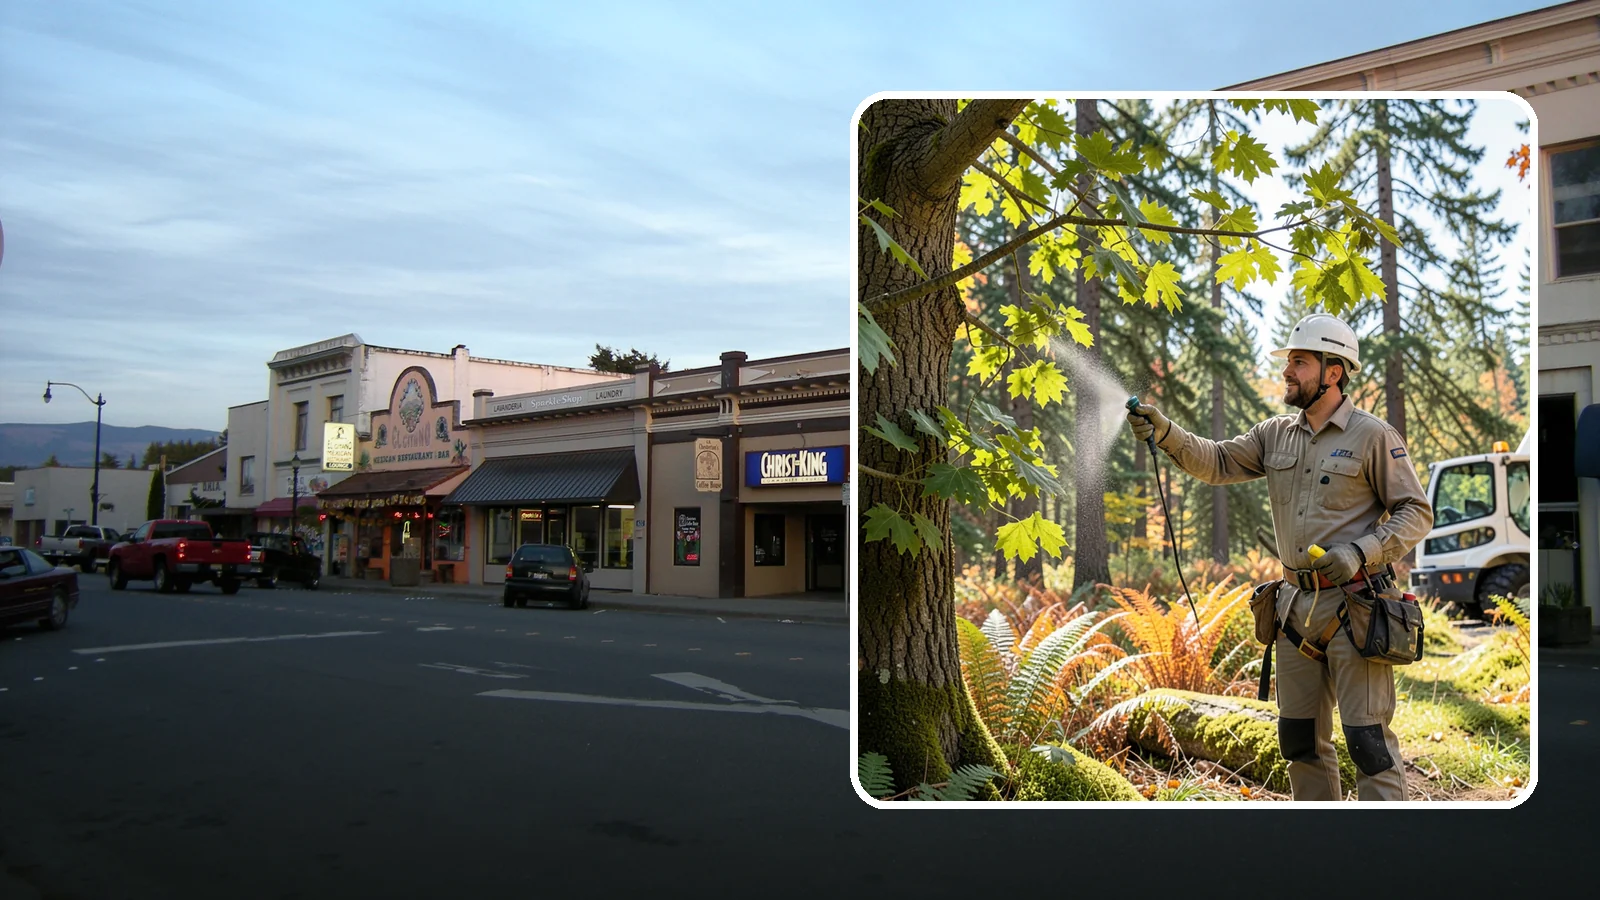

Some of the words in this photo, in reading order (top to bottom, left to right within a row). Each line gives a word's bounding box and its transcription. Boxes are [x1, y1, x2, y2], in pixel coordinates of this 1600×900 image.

[493, 402, 522, 412] LAVANDERIA
[531, 397, 560, 409] Sparkle
[562, 394, 582, 406] Shop
[595, 389, 623, 400] LAUNDRY
[397, 451, 434, 462] RESTAURANT
[438, 450, 450, 459] BAR
[761, 452, 797, 478] CHRIST
[799, 450, 827, 476] KING
